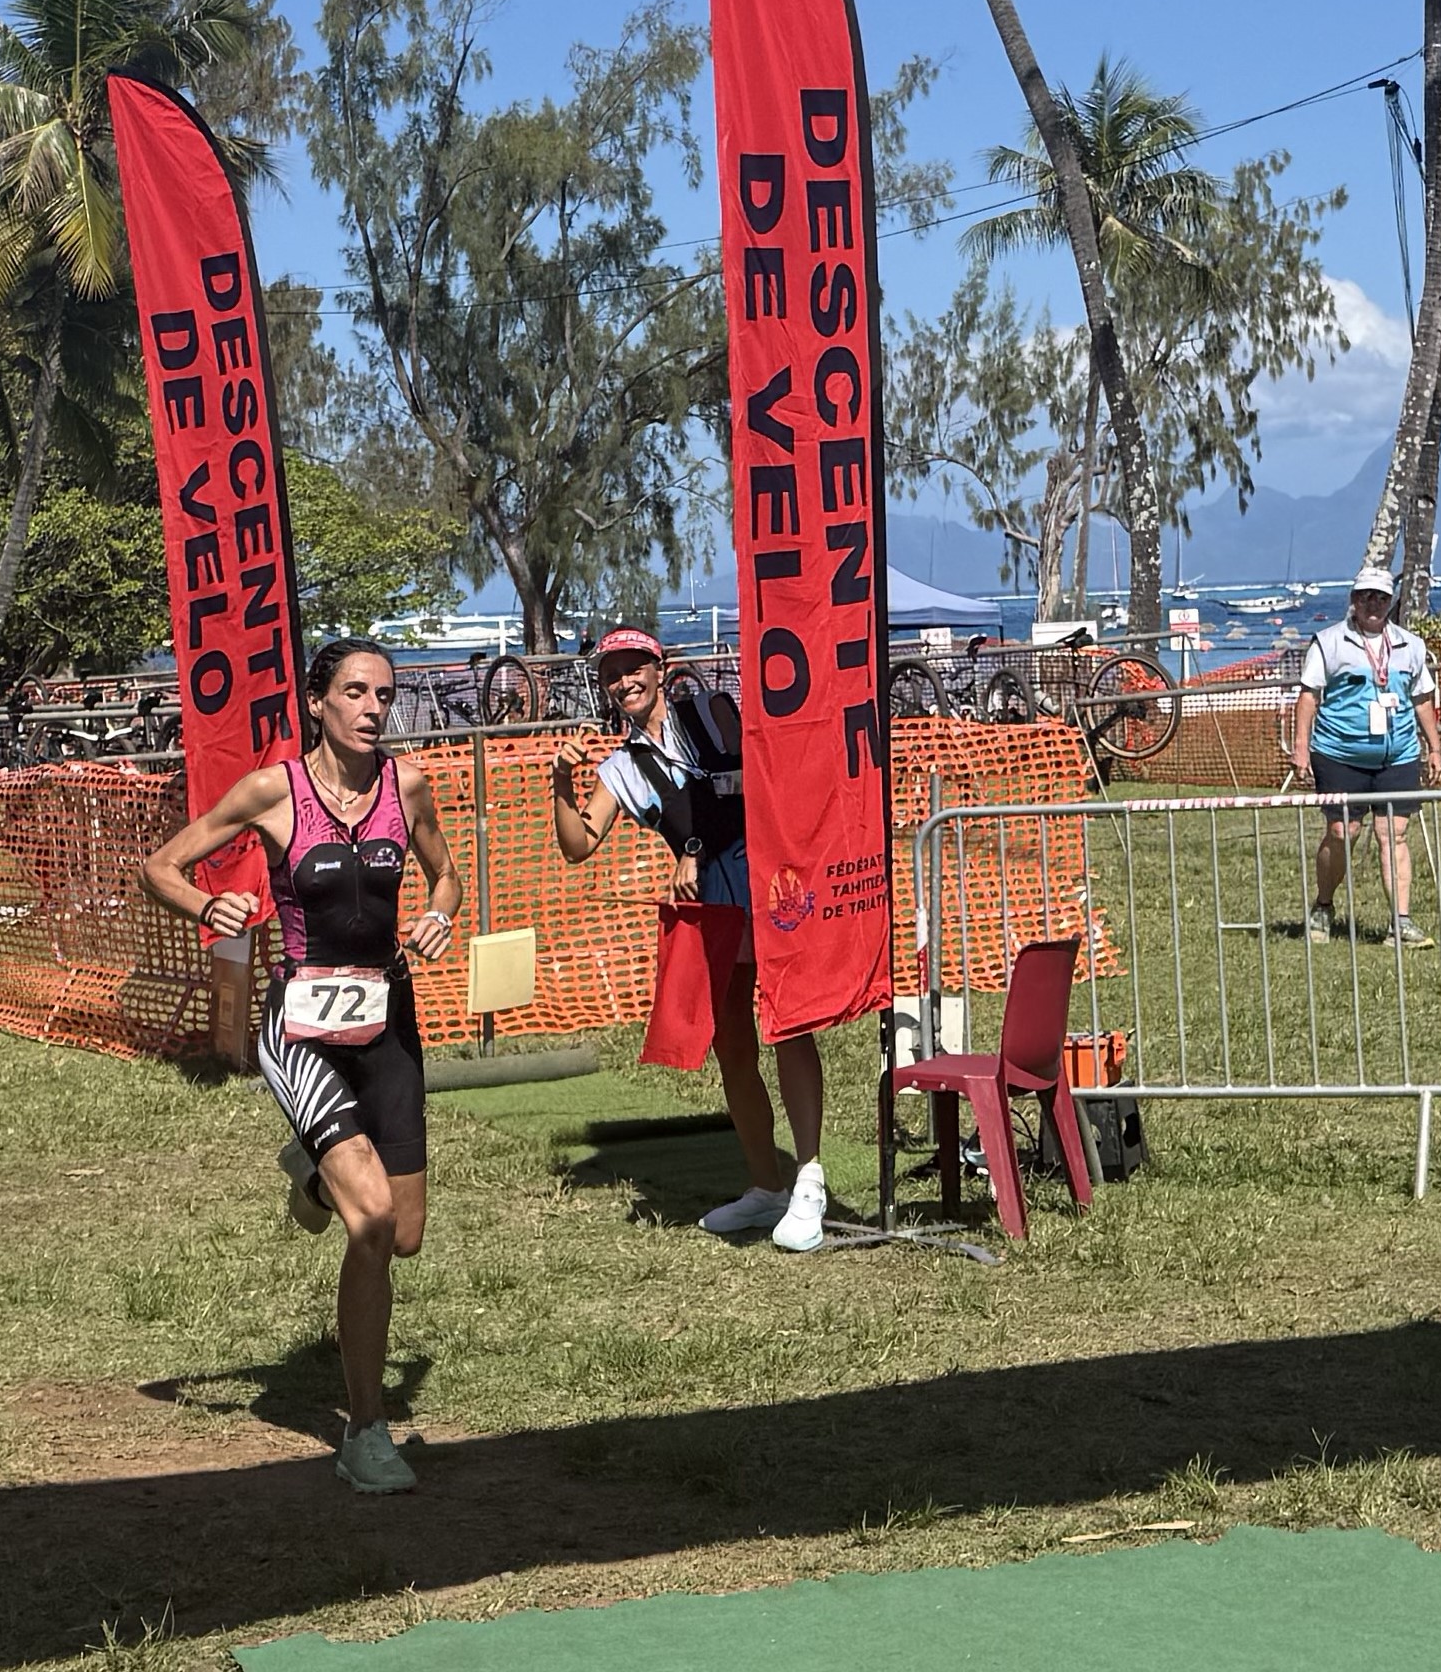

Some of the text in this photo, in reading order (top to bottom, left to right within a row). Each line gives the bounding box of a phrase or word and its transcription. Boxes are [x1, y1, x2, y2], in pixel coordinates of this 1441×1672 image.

[150, 308, 235, 716] DE VELO
[200, 251, 294, 755] DESCENTE
[739, 152, 812, 719] DE VELO
[799, 87, 882, 780] DESCENTE
[311, 984, 367, 1022] 72
[823, 905, 844, 921] DE
